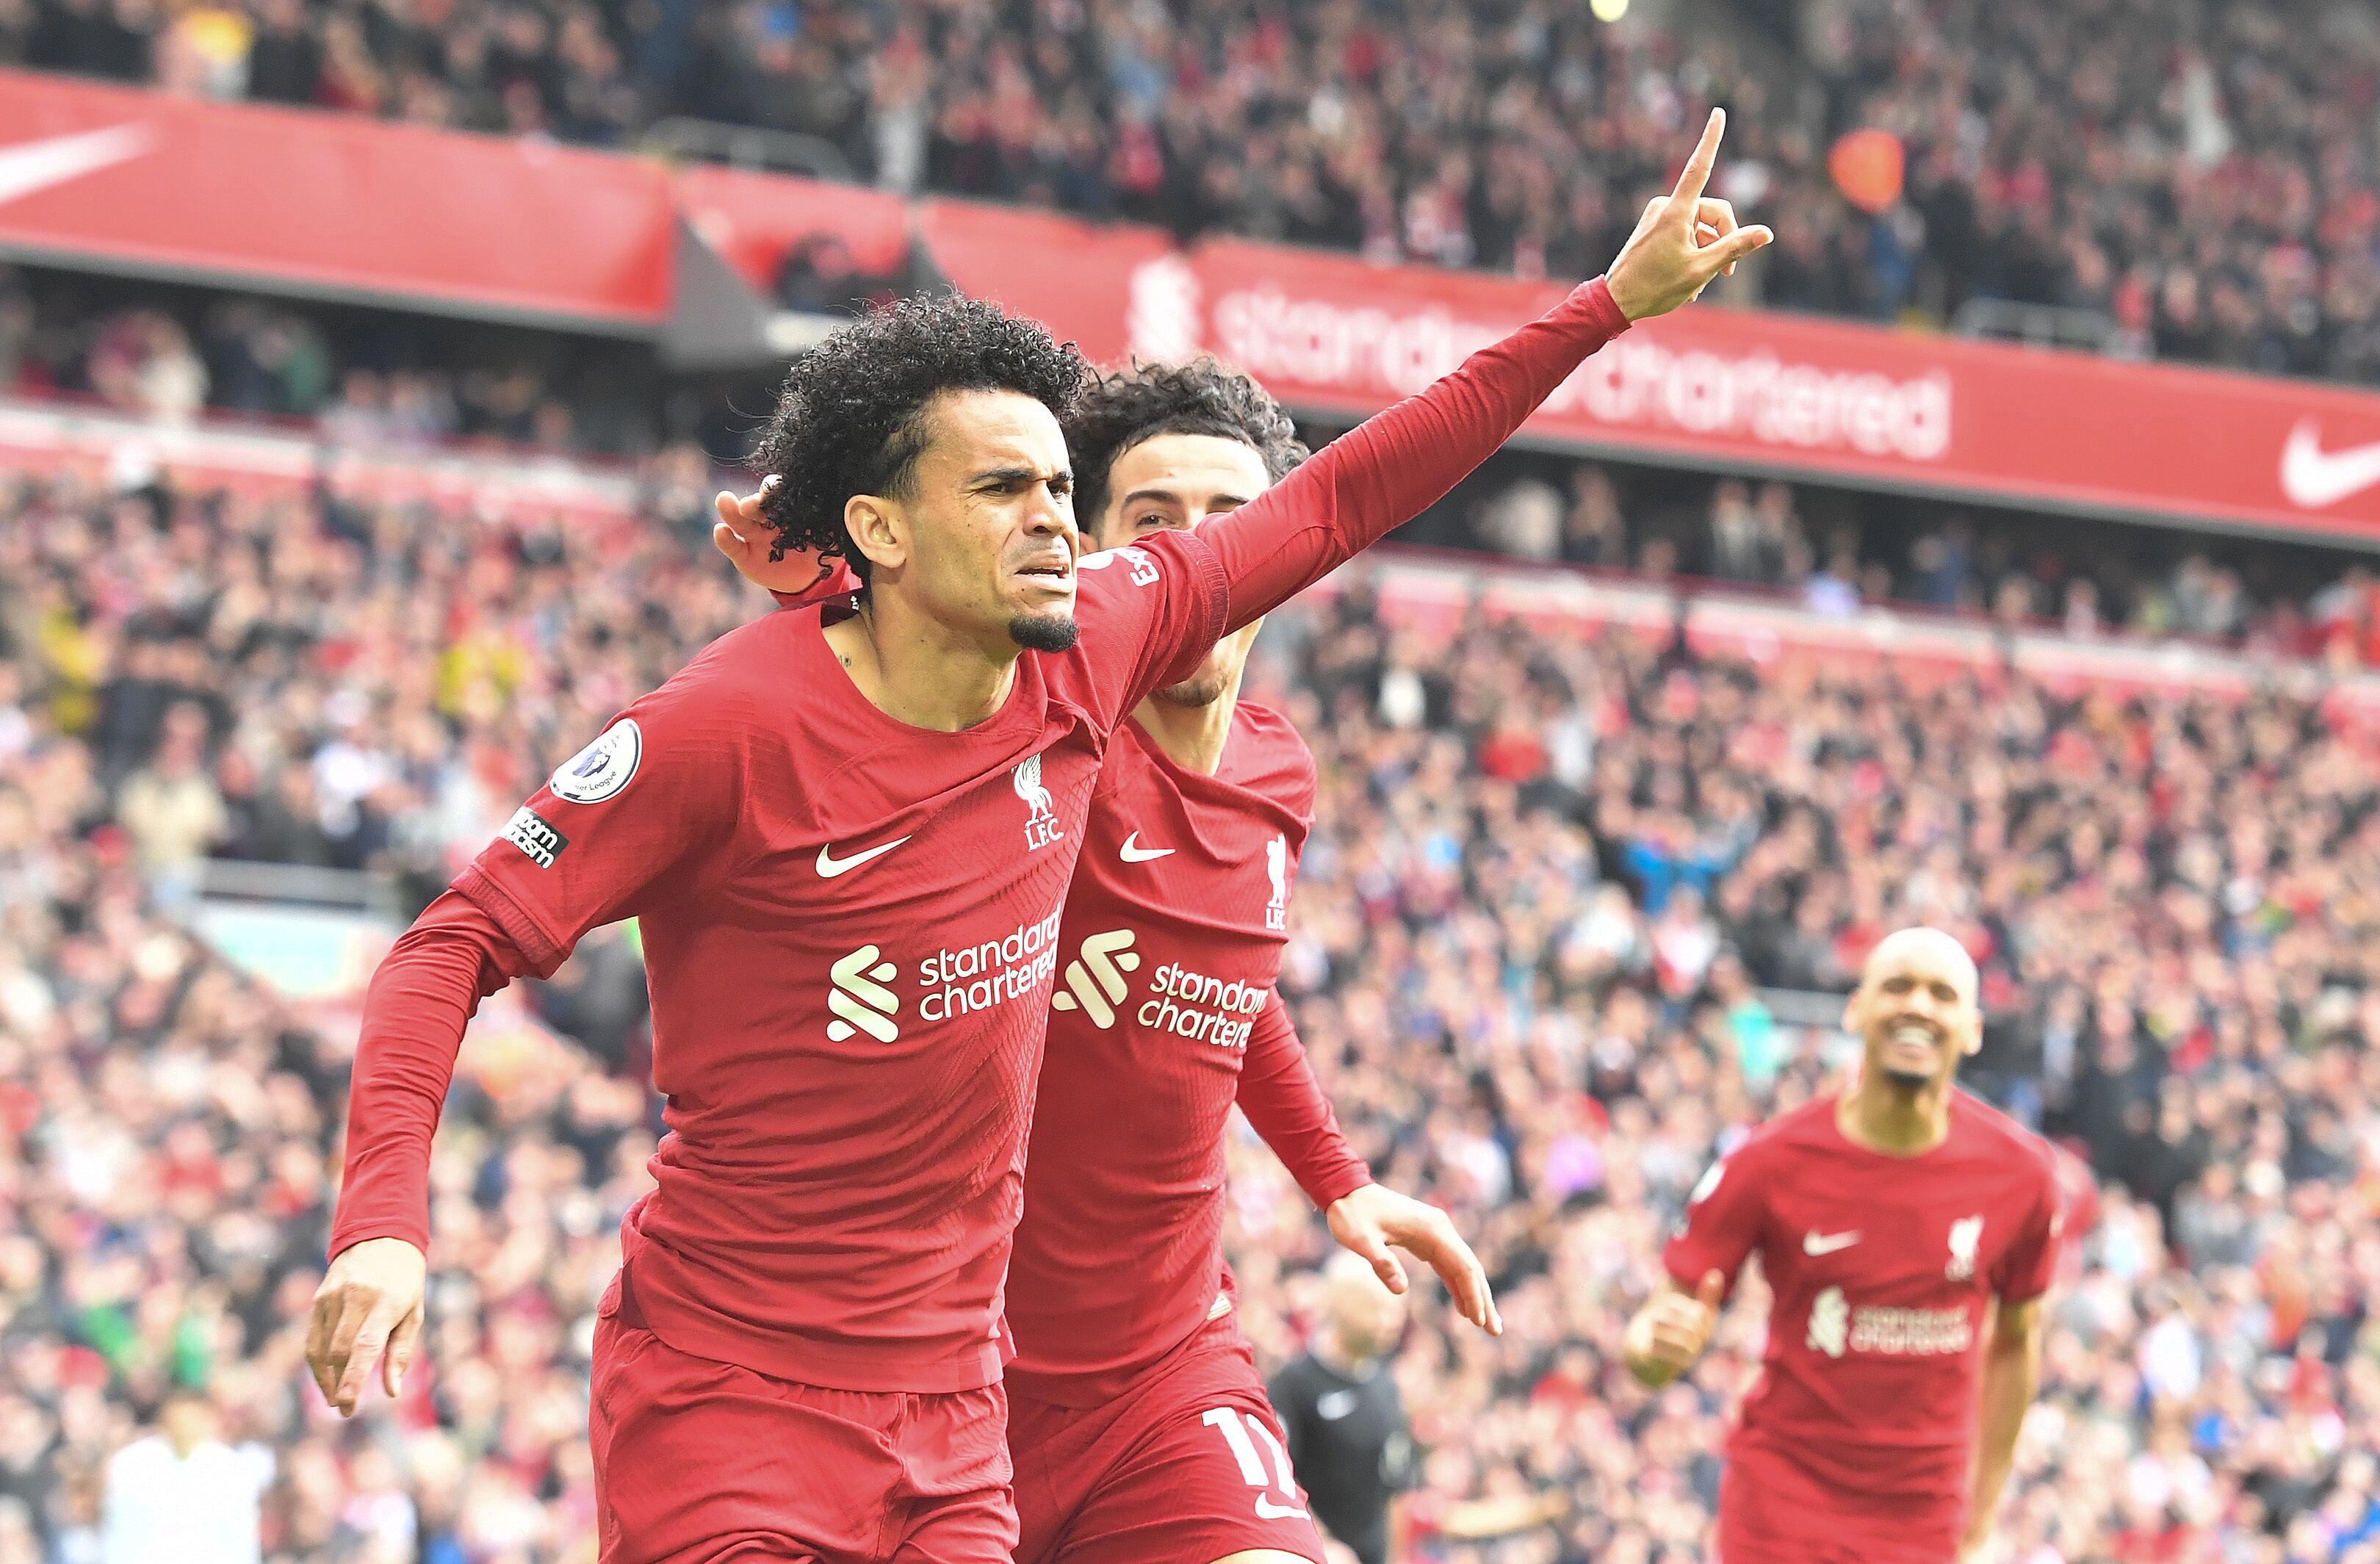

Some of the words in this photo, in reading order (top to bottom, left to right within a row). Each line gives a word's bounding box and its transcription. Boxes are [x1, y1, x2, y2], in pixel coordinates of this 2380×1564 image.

[920, 901, 1061, 987] standard
[920, 940, 1058, 1021] chartered
[1138, 996, 1253, 1048] chartere
